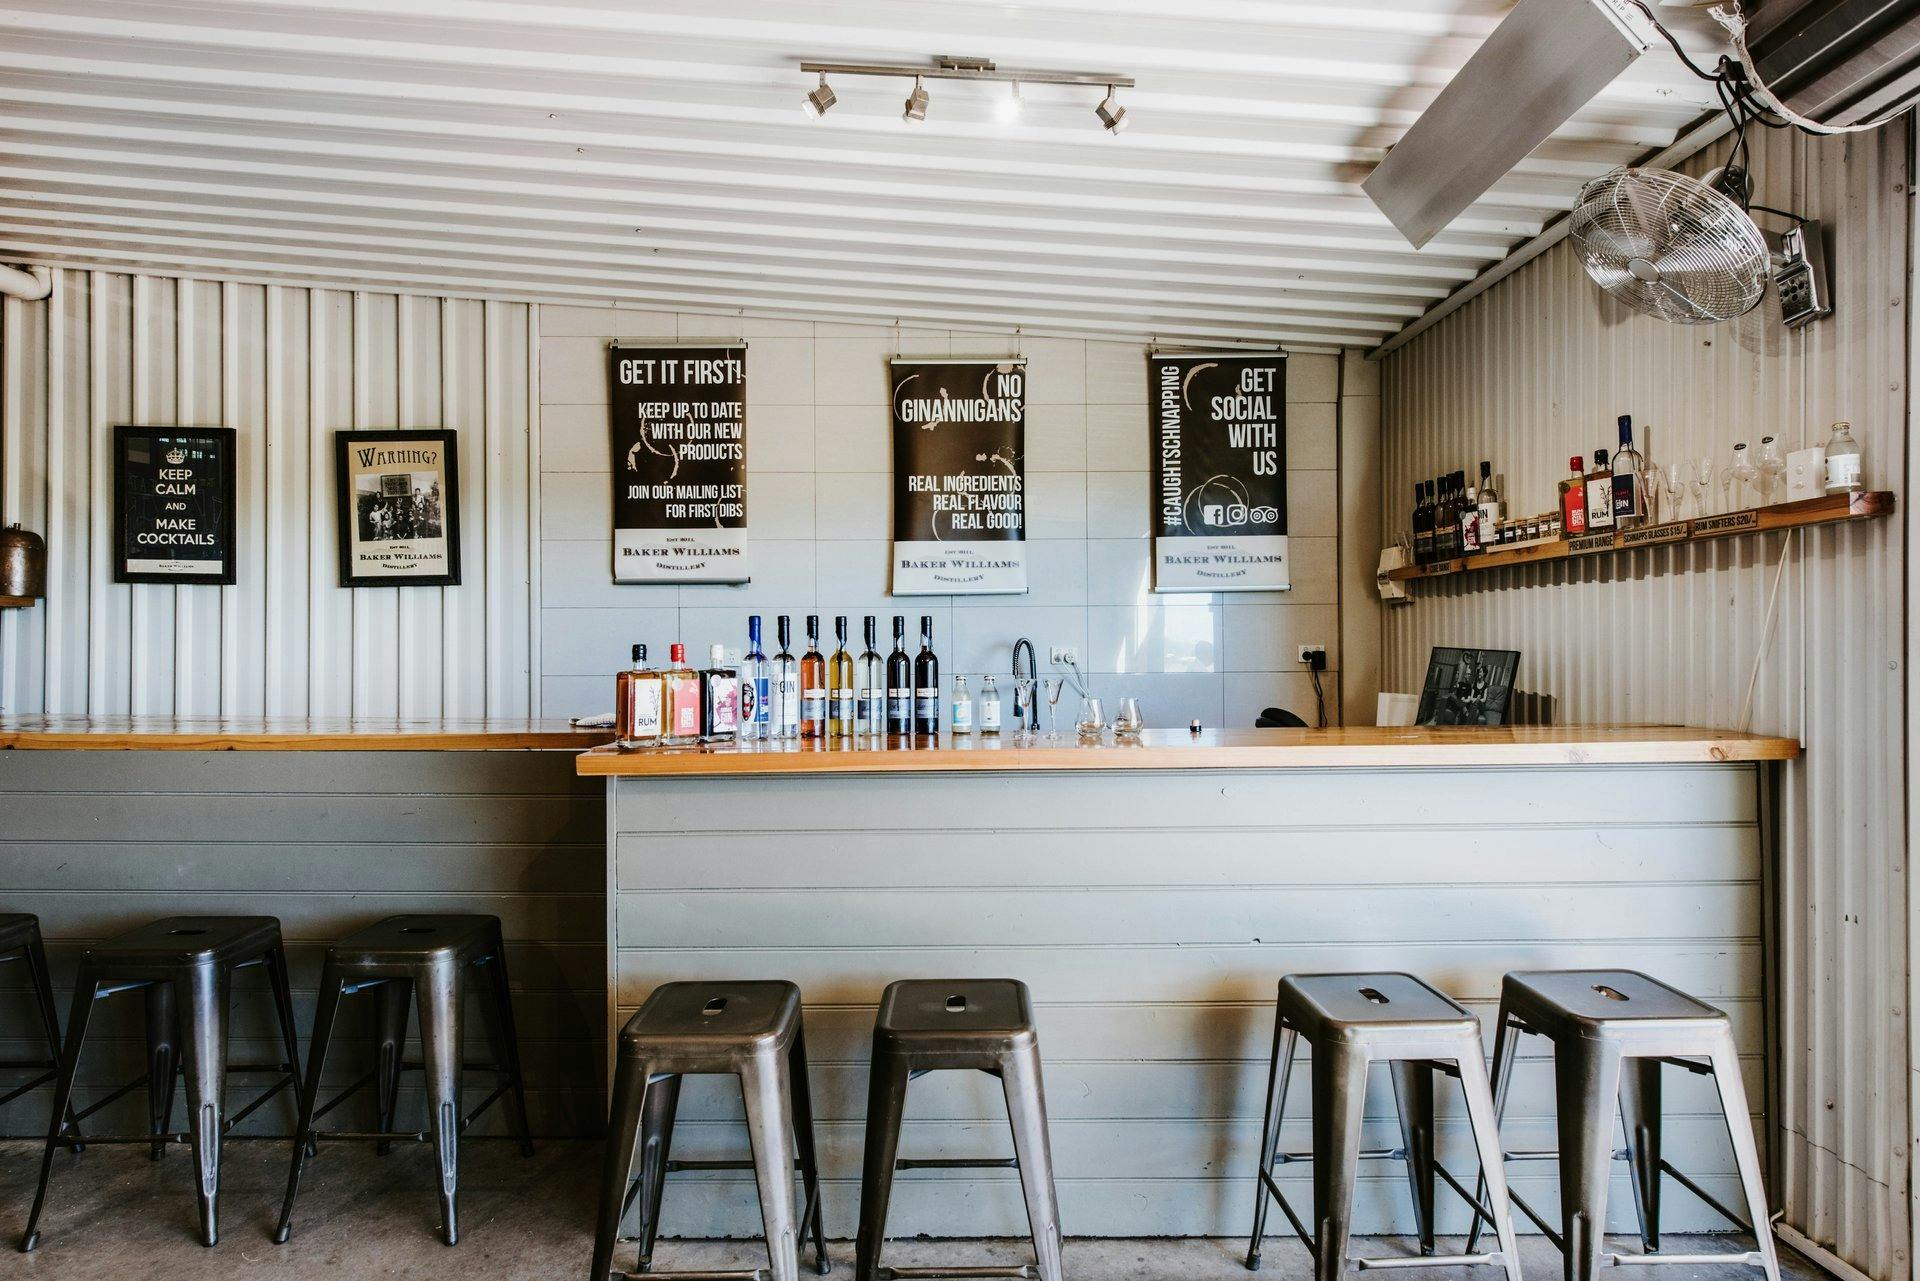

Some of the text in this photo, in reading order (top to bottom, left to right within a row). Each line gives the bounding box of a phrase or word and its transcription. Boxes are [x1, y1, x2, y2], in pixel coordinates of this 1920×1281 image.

[620, 360, 742, 384] GET IT FIRST!
[997, 374, 1022, 398] NO
[1241, 368, 1277, 392] GET
[638, 402, 742, 418] KEEP UP TO DATE
[901, 399, 1022, 422] GINANNIGANS
[1211, 396, 1277, 420] SOCIAL
[651, 422, 743, 439] WITH OUR NEW
[1228, 423, 1276, 448] WITH
[680, 443, 742, 460] PRODUCTS
[1161, 366, 1182, 526] #CAUGHTSCHNAPPING
[357, 447, 437, 468] WARNING?
[1253, 451, 1277, 475] US
[159, 468, 193, 480] KEEP
[155, 483, 196, 495] CALM
[908, 475, 1022, 492] REAL INGREDIENTS
[627, 484, 743, 499] JOIN OUR MAILING LIST
[165, 502, 187, 511] AND
[933, 494, 1022, 511] REAL FLAVOUR
[666, 503, 743, 518] FOR FIRST DIBS
[1591, 511, 1609, 519] RUM
[156, 518, 196, 530] MAKE
[952, 512, 1022, 530] REAL GOOD!
[1708, 517, 1736, 529] SNIFTERS
[137, 533, 215, 545] COCKTAILS
[1624, 530, 1648, 542] SCHNAPPS
[1648, 527, 1670, 539] GLASSES
[1569, 535, 1613, 551] PREMIUM RANGE
[623, 547, 740, 556] BAKER WILLIAMS
[1165, 554, 1282, 564] BAKER WILLIAMS
[656, 562, 706, 571] DISTILLERY
[901, 560, 1020, 568] BAKER WILLIAMS
[934, 574, 984, 583] DISTILLERY
[1197, 568, 1247, 578] DISTILLERY
[638, 718, 657, 726] RUM
